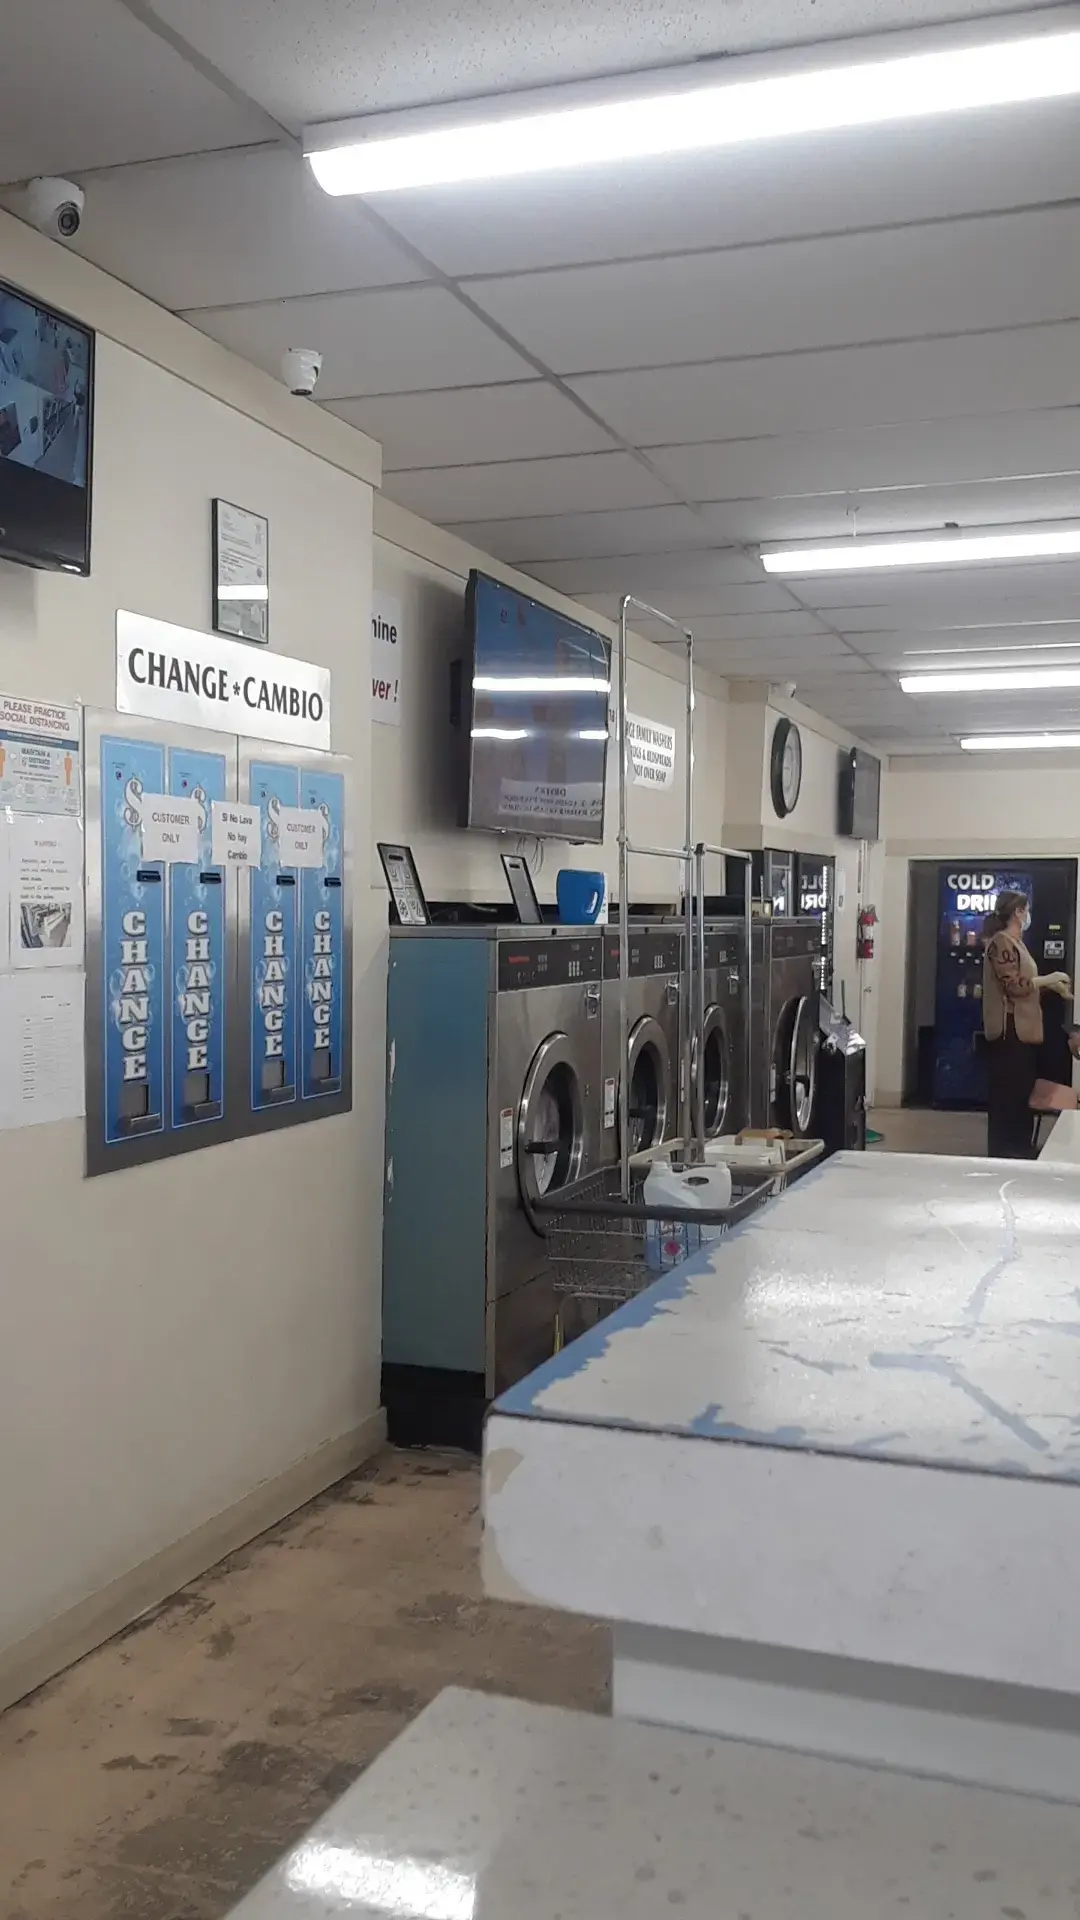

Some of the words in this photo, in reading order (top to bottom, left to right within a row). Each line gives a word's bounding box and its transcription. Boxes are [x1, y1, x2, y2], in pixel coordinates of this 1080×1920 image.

[3, 700, 33, 714] PLEASE
[34, 706, 67, 721] PRACTICE
[0, 710, 28, 724] SOCIAL
[29, 716, 70, 731] DISTANCING
[653, 730, 673, 750] WASHERS
[643, 766, 655, 779] OVER
[655, 769, 667, 782] SOAP
[151, 812, 191, 825] CUSTOMER
[230, 813, 238, 823] No
[239, 814, 253, 825] Lava
[227, 831, 237, 841] No
[286, 823, 316, 834] CUSTOMER
[161, 832, 180, 844] ONLY
[294, 841, 309, 851] ONLY
[227, 849, 248, 860] Cambio
[947, 874, 995, 890] COLD
[262, 910, 285, 1058] CHANGE
[312, 910, 333, 1049] CHANGE
[119, 910, 150, 1081] CHANGE
[184, 910, 211, 1070] CHANGE
